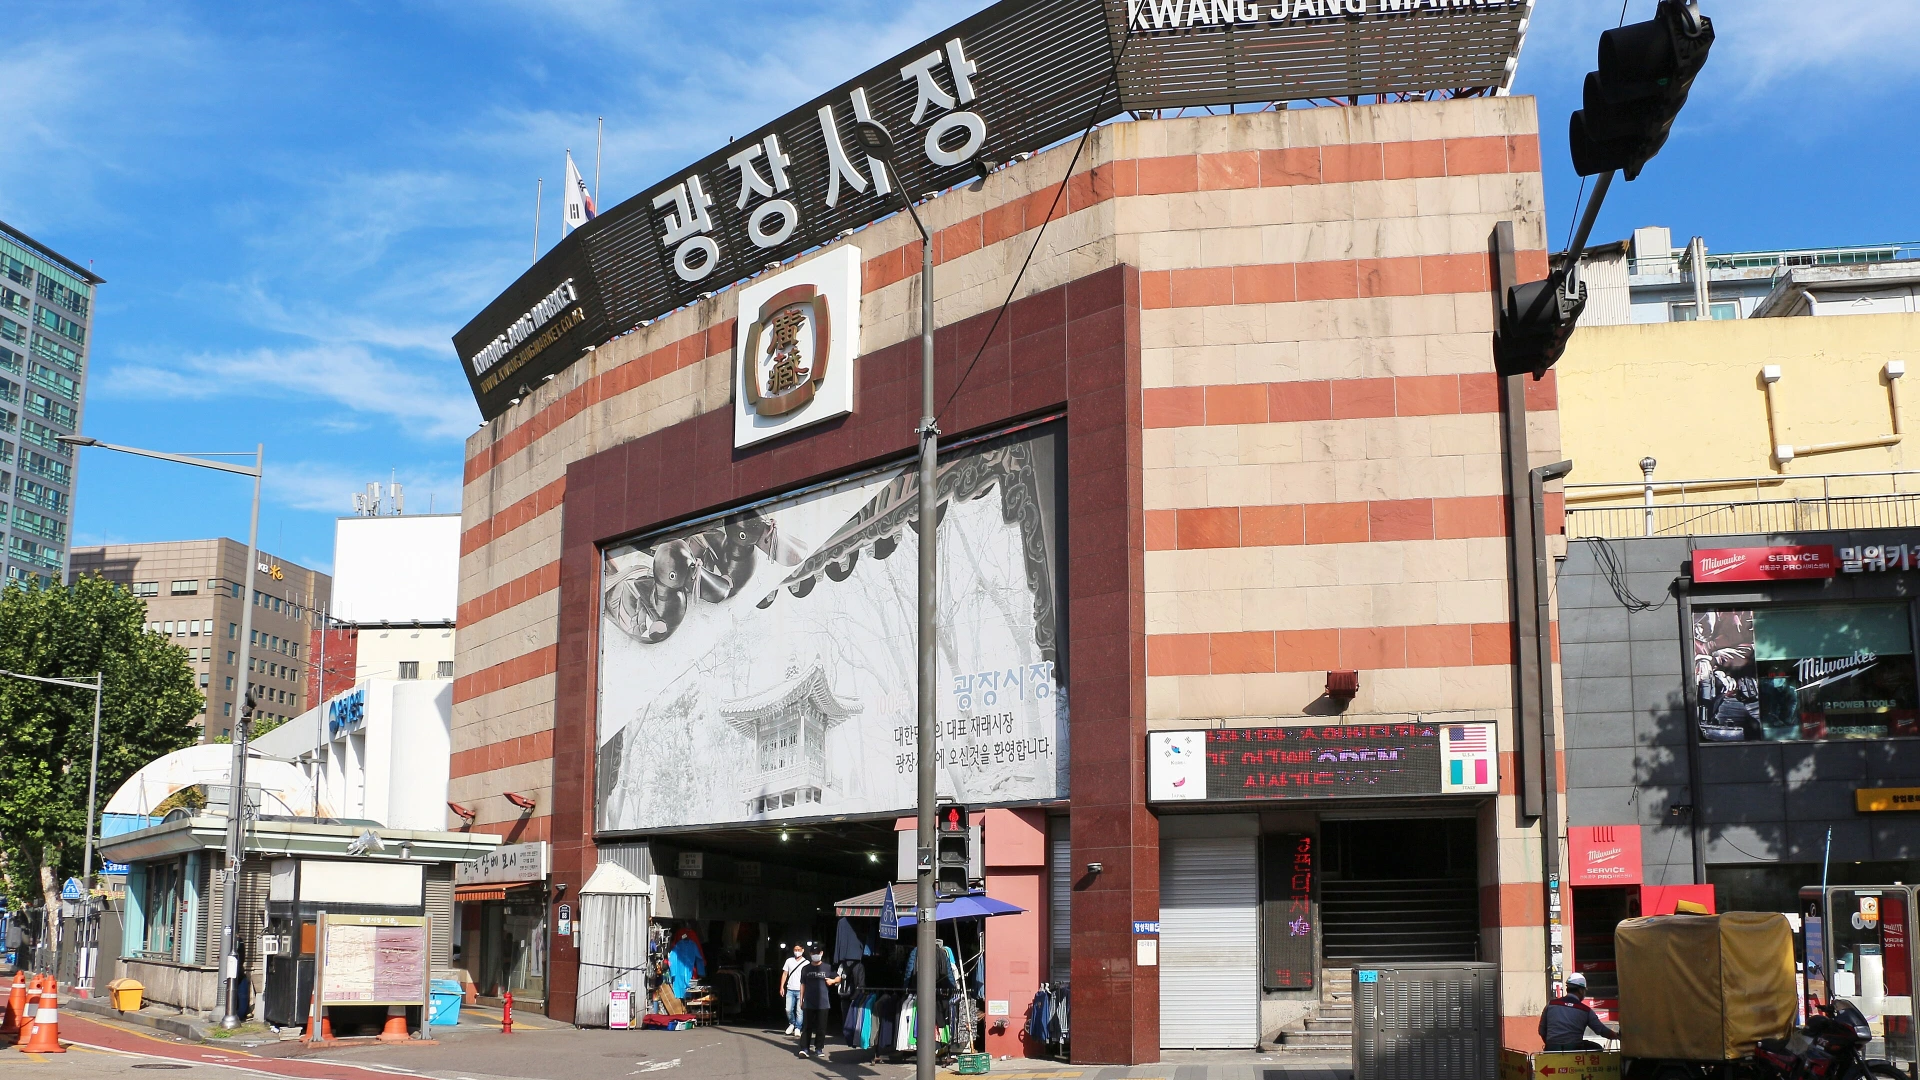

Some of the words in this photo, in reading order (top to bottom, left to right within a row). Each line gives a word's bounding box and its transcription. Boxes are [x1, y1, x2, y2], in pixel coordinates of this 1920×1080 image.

[652, 37, 987, 282] 광장시장
[471, 334, 509, 376] KWANG
[506, 312, 536, 350] JANG
[530, 277, 578, 330] MARKET
[1699, 553, 1747, 572] Milwaukee
[1768, 552, 1819, 562] SERVICE
[1840, 544, 1909, 573] 밀워키
[1793, 651, 1878, 683] Milwaukee
[953, 662, 1054, 710] 광장시장
[946, 719, 967, 741] 대표
[970, 712, 1014, 737] 재래시장
[948, 744, 991, 767] 오신것을
